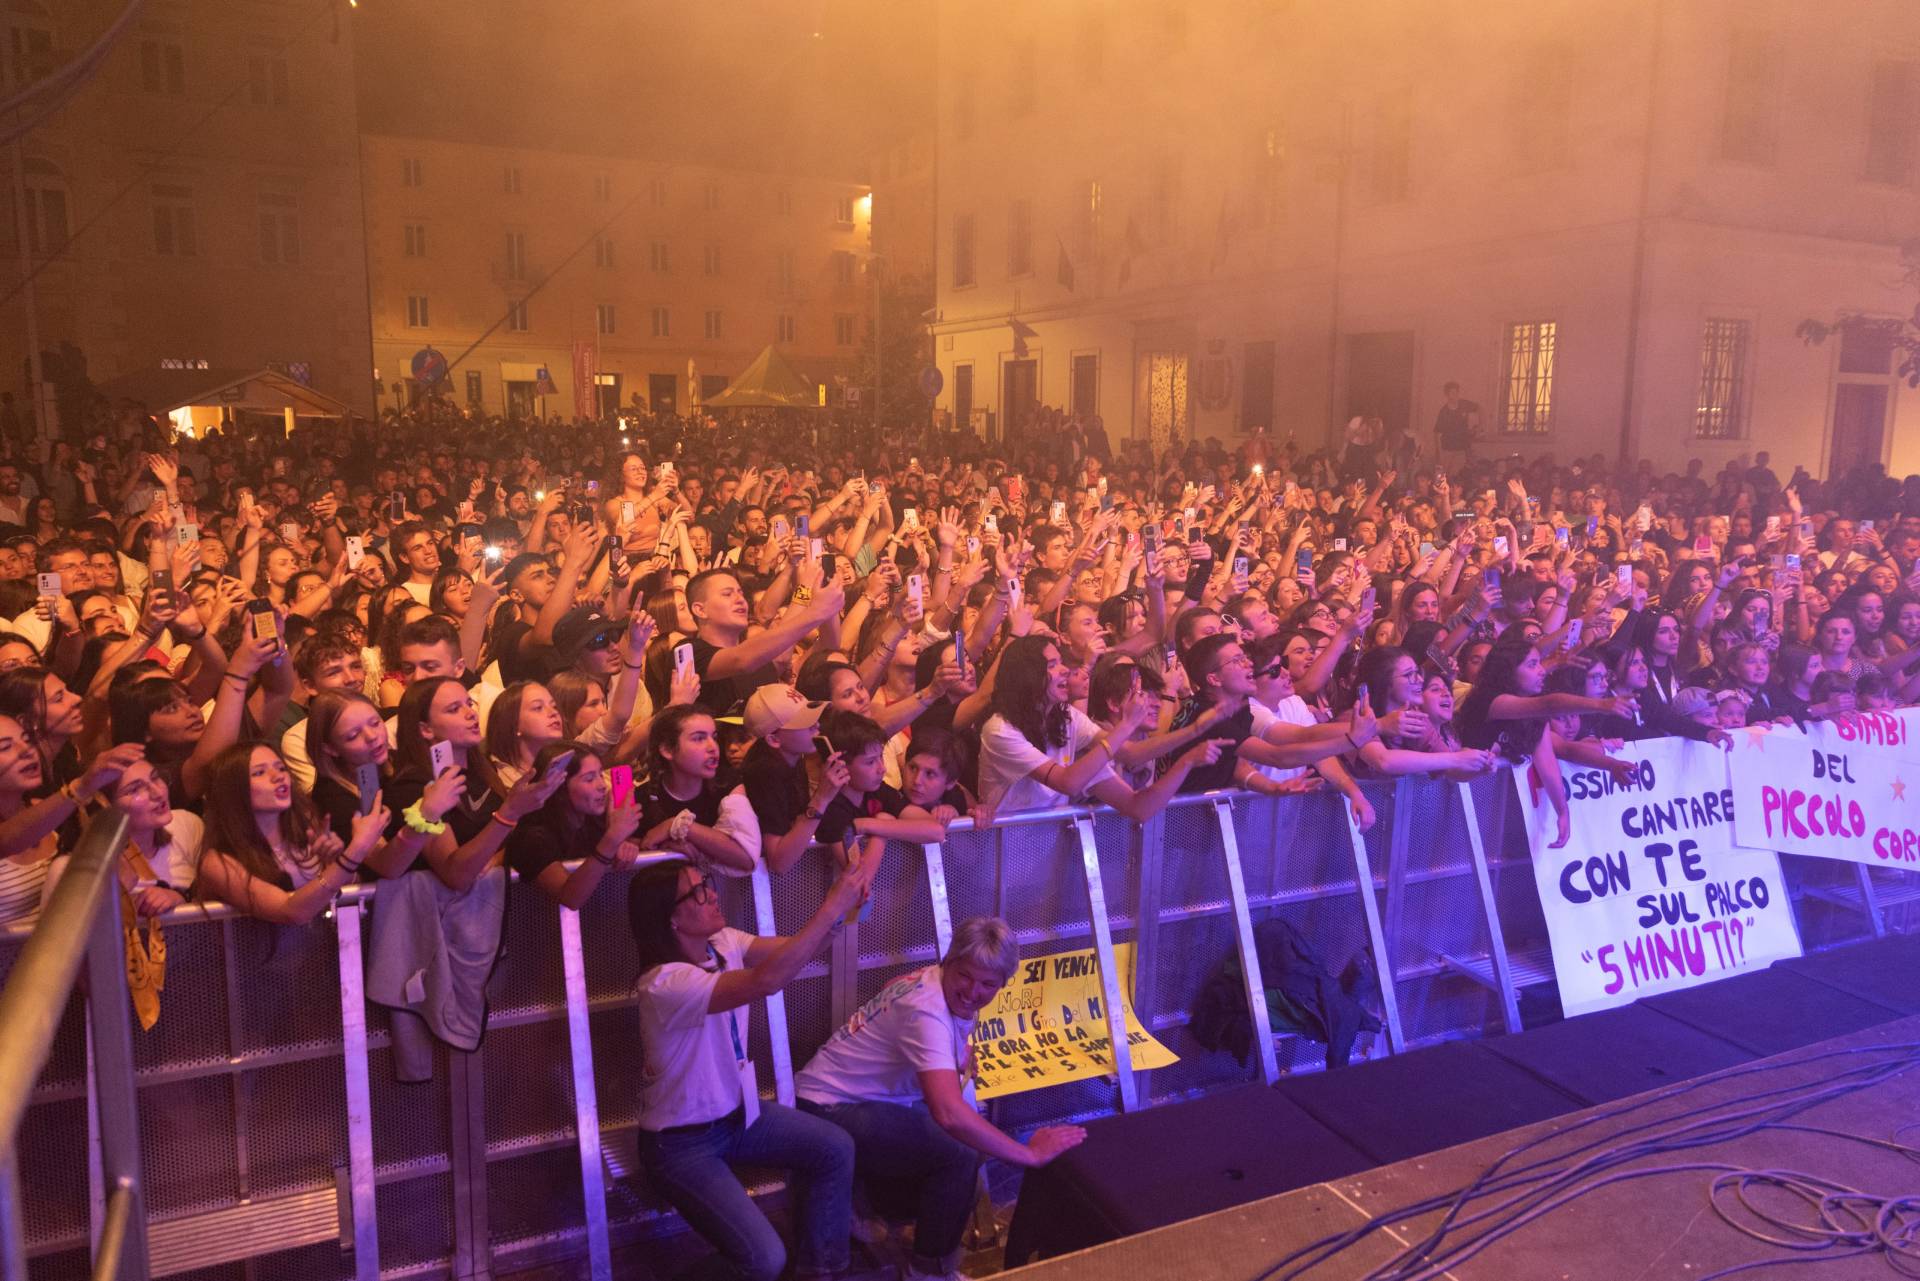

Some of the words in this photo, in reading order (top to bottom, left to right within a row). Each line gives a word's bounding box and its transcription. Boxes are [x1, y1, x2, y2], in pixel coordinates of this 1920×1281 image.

[1812, 749, 1856, 783] DEL
[1621, 789, 1735, 838] CANTARE
[1762, 785, 1866, 838] PICCOLO
[1873, 827, 1920, 862] COR
[1559, 849, 1631, 903] CON
[1644, 839, 1706, 888] TE
[1637, 891, 1700, 928] SUL
[1705, 876, 1769, 918] PALCO
[1024, 959, 1046, 984] SEI
[1053, 953, 1097, 979] VENUT
[998, 1037, 1031, 1056] ORA
[1035, 1031, 1059, 1048] HO
[1064, 1026, 1088, 1042] LA
